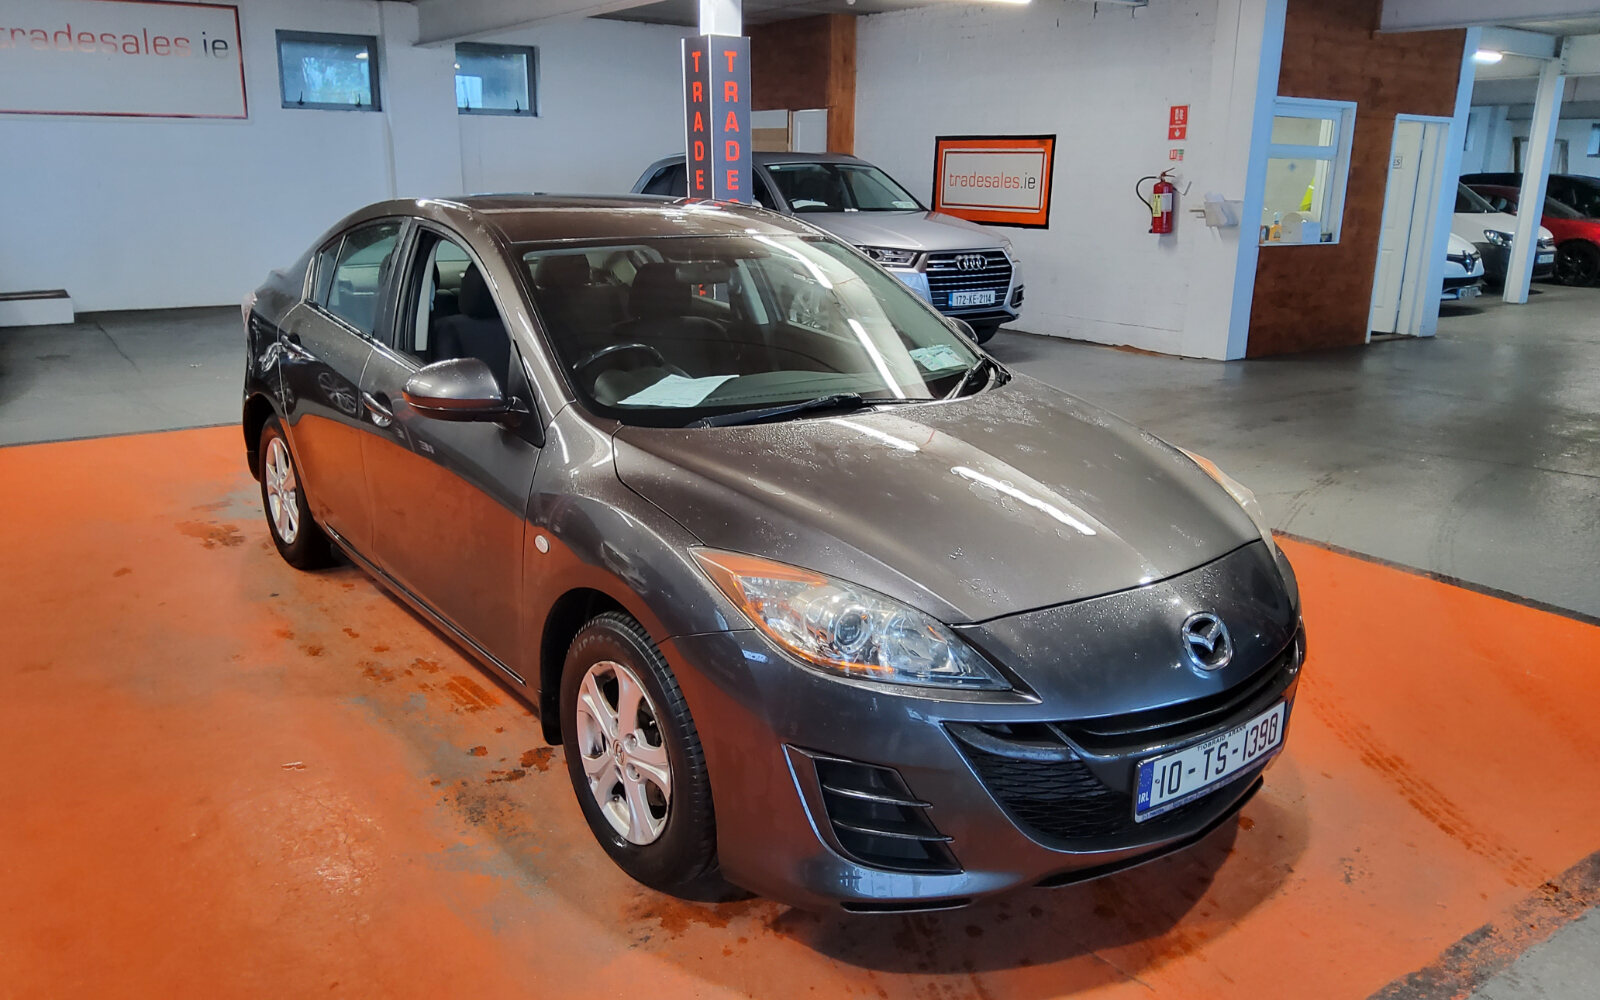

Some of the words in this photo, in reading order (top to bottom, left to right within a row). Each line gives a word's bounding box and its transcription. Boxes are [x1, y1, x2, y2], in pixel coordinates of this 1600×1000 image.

[723, 51, 740, 203] TRADE
[949, 171, 1036, 189] tradesales.ie
[1138, 791, 1150, 805] IRL
